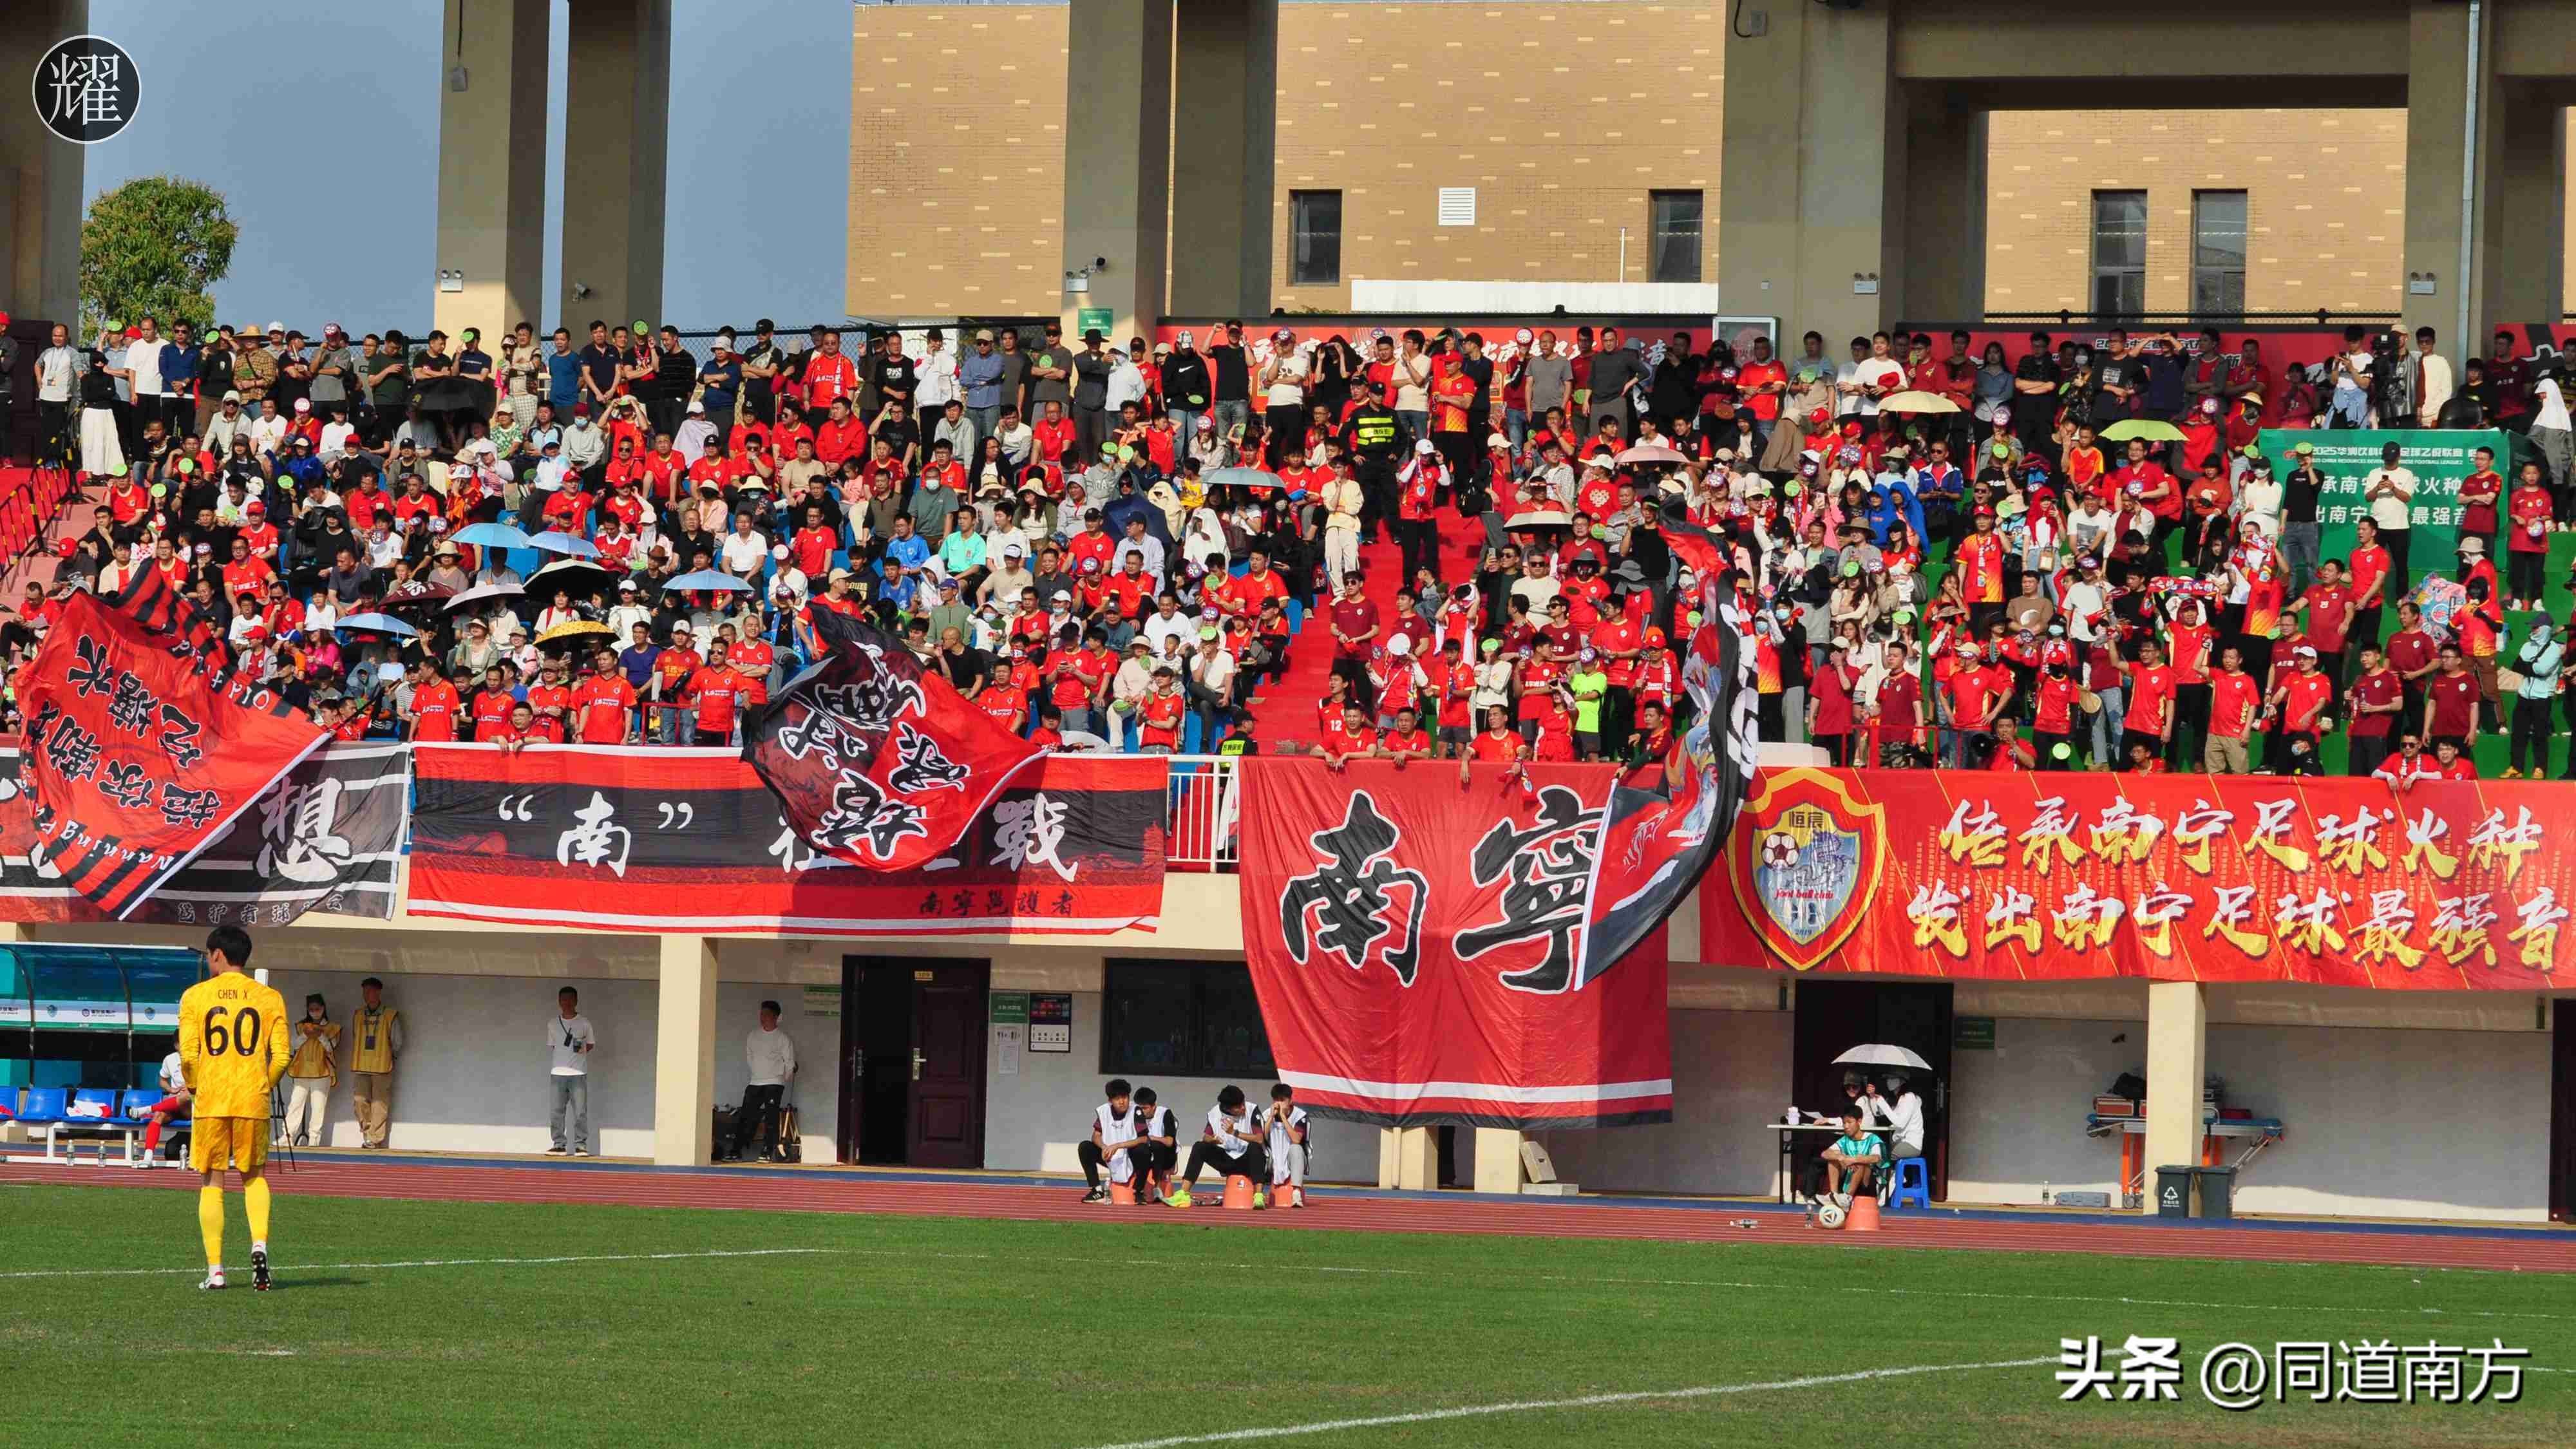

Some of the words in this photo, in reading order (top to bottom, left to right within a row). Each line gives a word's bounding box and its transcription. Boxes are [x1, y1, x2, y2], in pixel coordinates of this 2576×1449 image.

[1330, 719, 1342, 732] 12
[61, 819, 175, 871] Nanning
[1939, 795, 2544, 885] 传承南宁足球火种
[1906, 877, 2570, 971] 发出南宁足球最强音
[218, 989, 238, 1000] CHEN
[204, 1005, 261, 1056] 60
